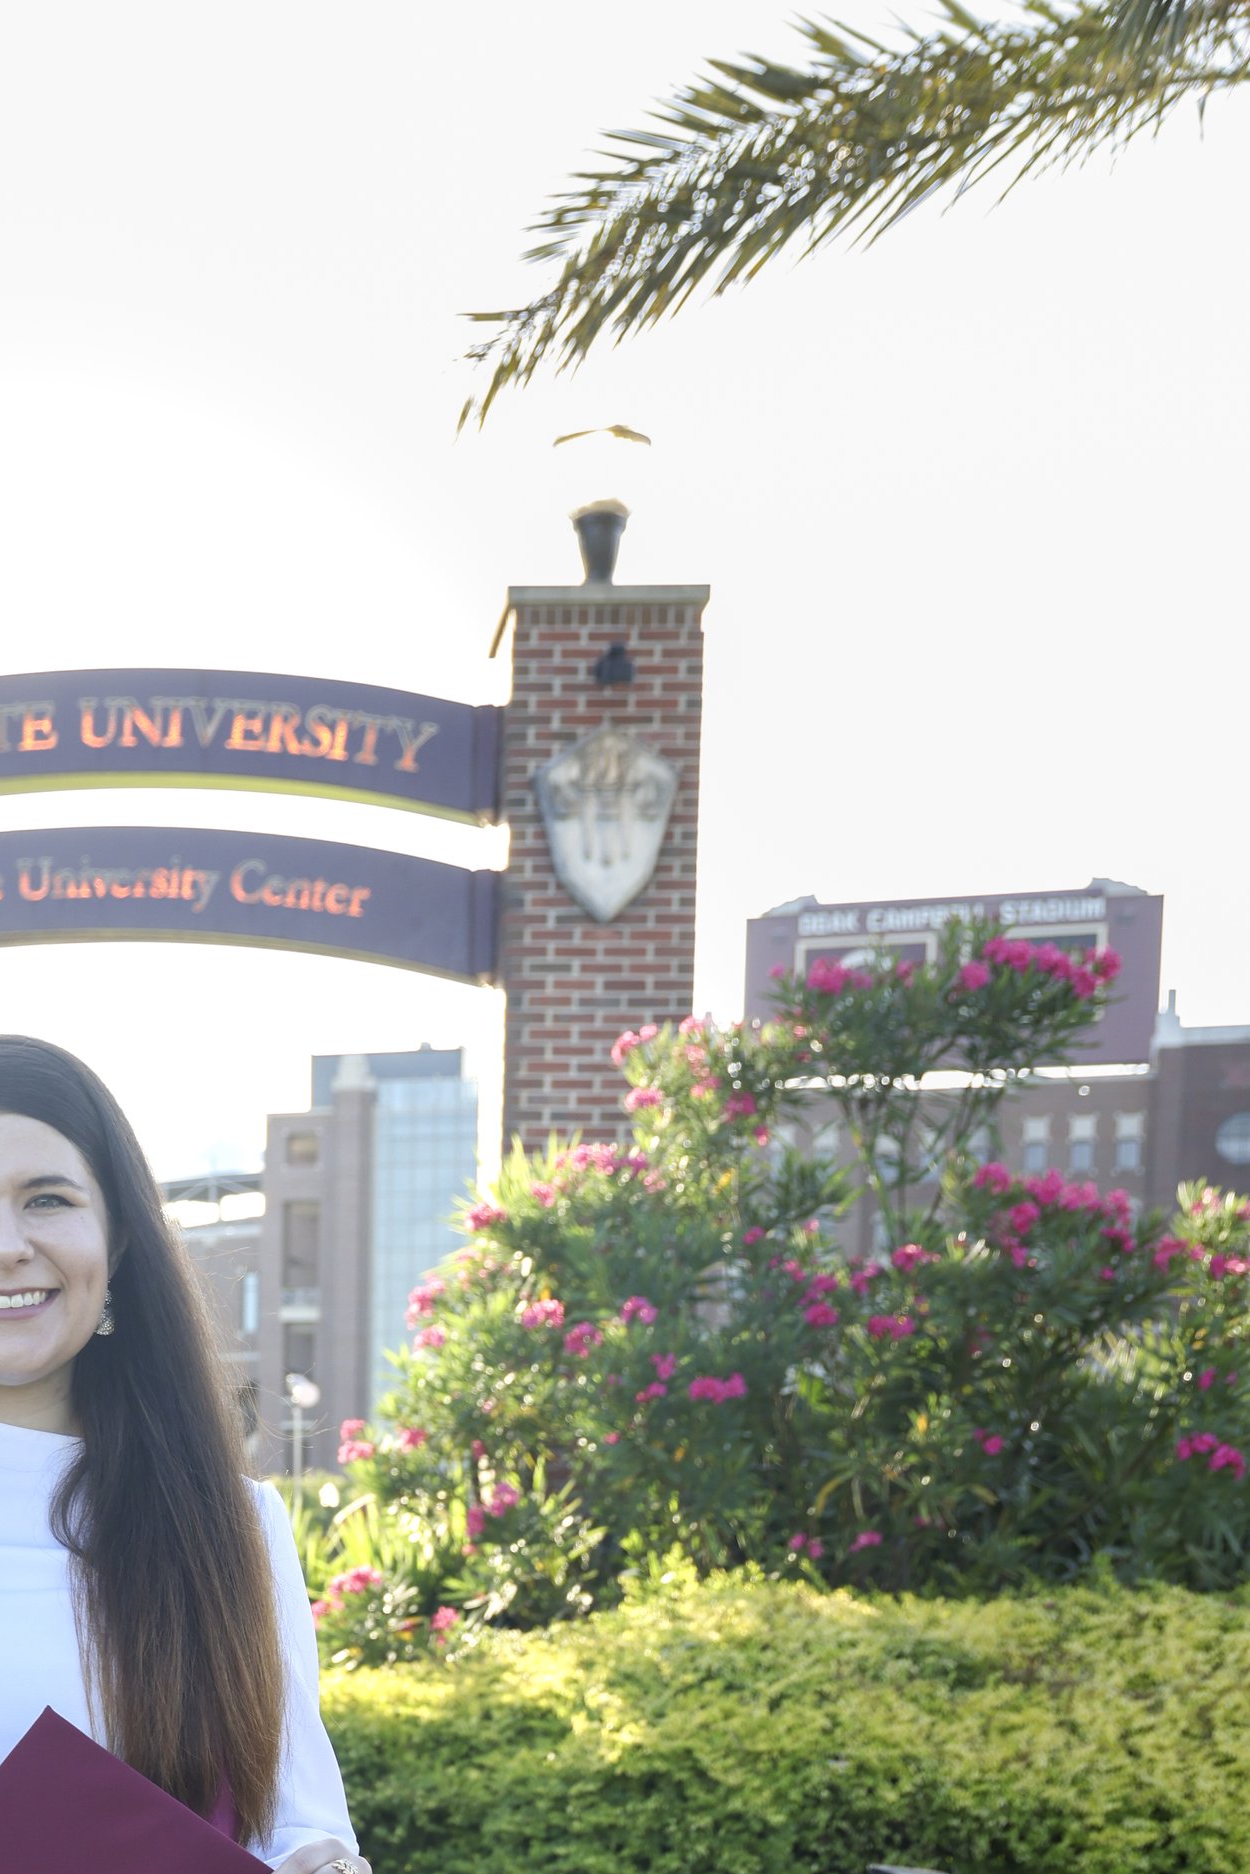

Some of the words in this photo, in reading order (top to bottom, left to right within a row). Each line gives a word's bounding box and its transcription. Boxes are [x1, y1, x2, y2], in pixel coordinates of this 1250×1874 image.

[79, 697, 438, 773] UNIVERSITY
[16, 854, 220, 913] University
[230, 858, 371, 918] Center
